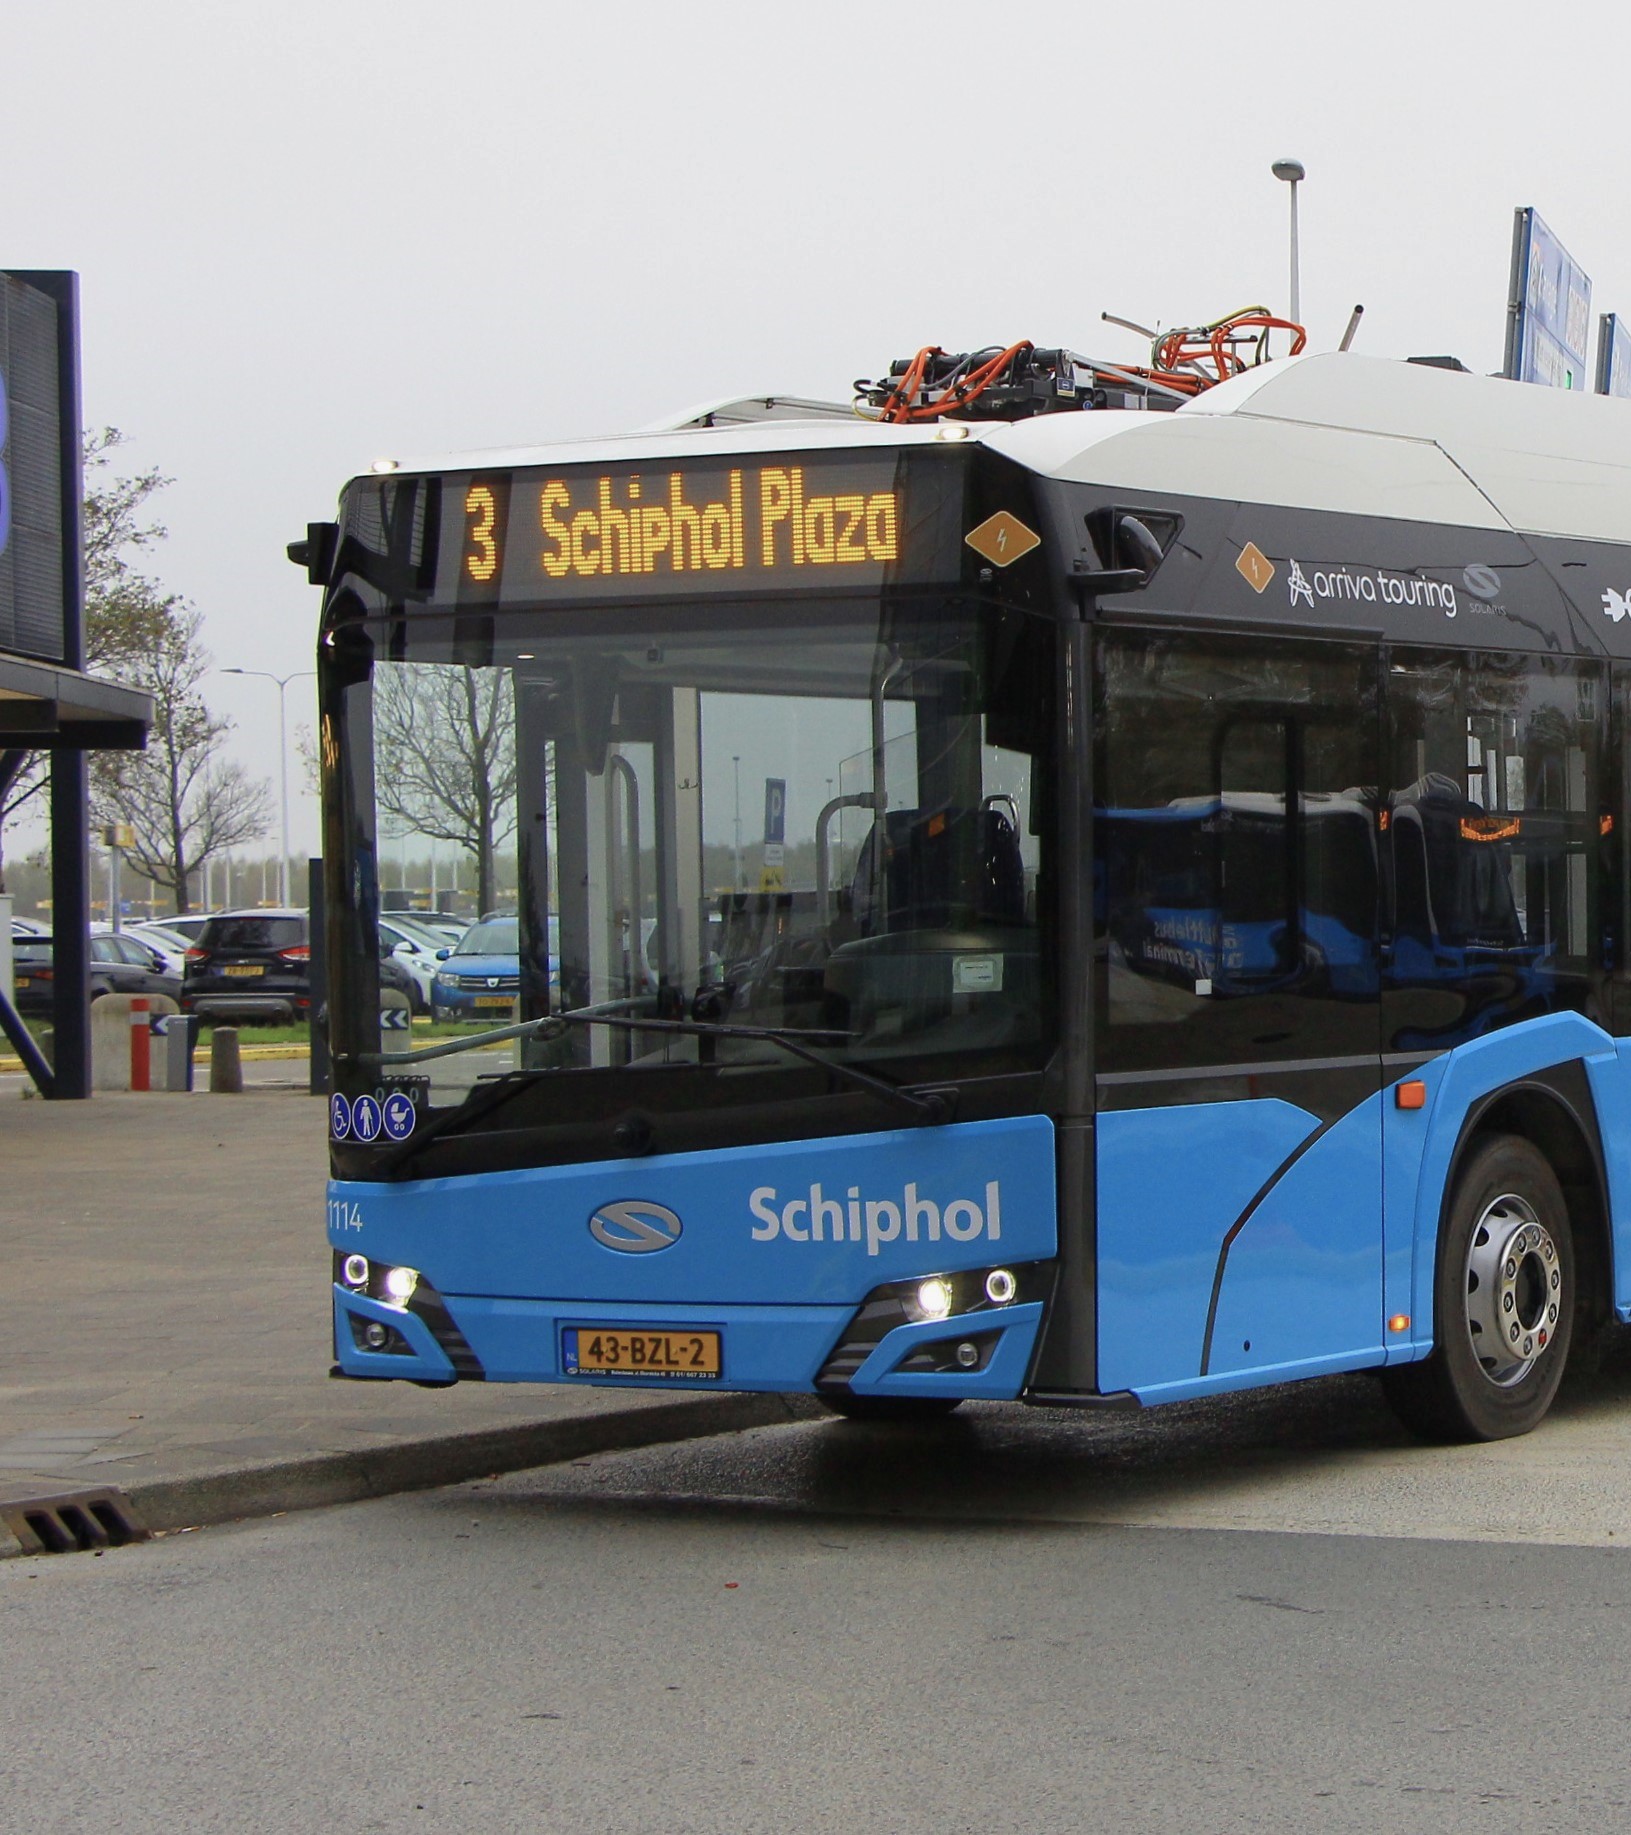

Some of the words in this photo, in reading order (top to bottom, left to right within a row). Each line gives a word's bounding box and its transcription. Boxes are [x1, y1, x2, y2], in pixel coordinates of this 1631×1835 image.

[466, 487, 496, 580] 3
[541, 469, 743, 577] Schiphol
[761, 466, 898, 566] Plaza
[1314, 567, 1376, 602] arriva
[1377, 571, 1457, 618] touring
[1470, 602, 1507, 616] SOLARIS
[328, 1200, 363, 1232] 1114
[750, 1181, 1001, 1256] Schiphol
[567, 1353, 577, 1361] NL
[588, 1336, 705, 1366] 43-BZL-2
